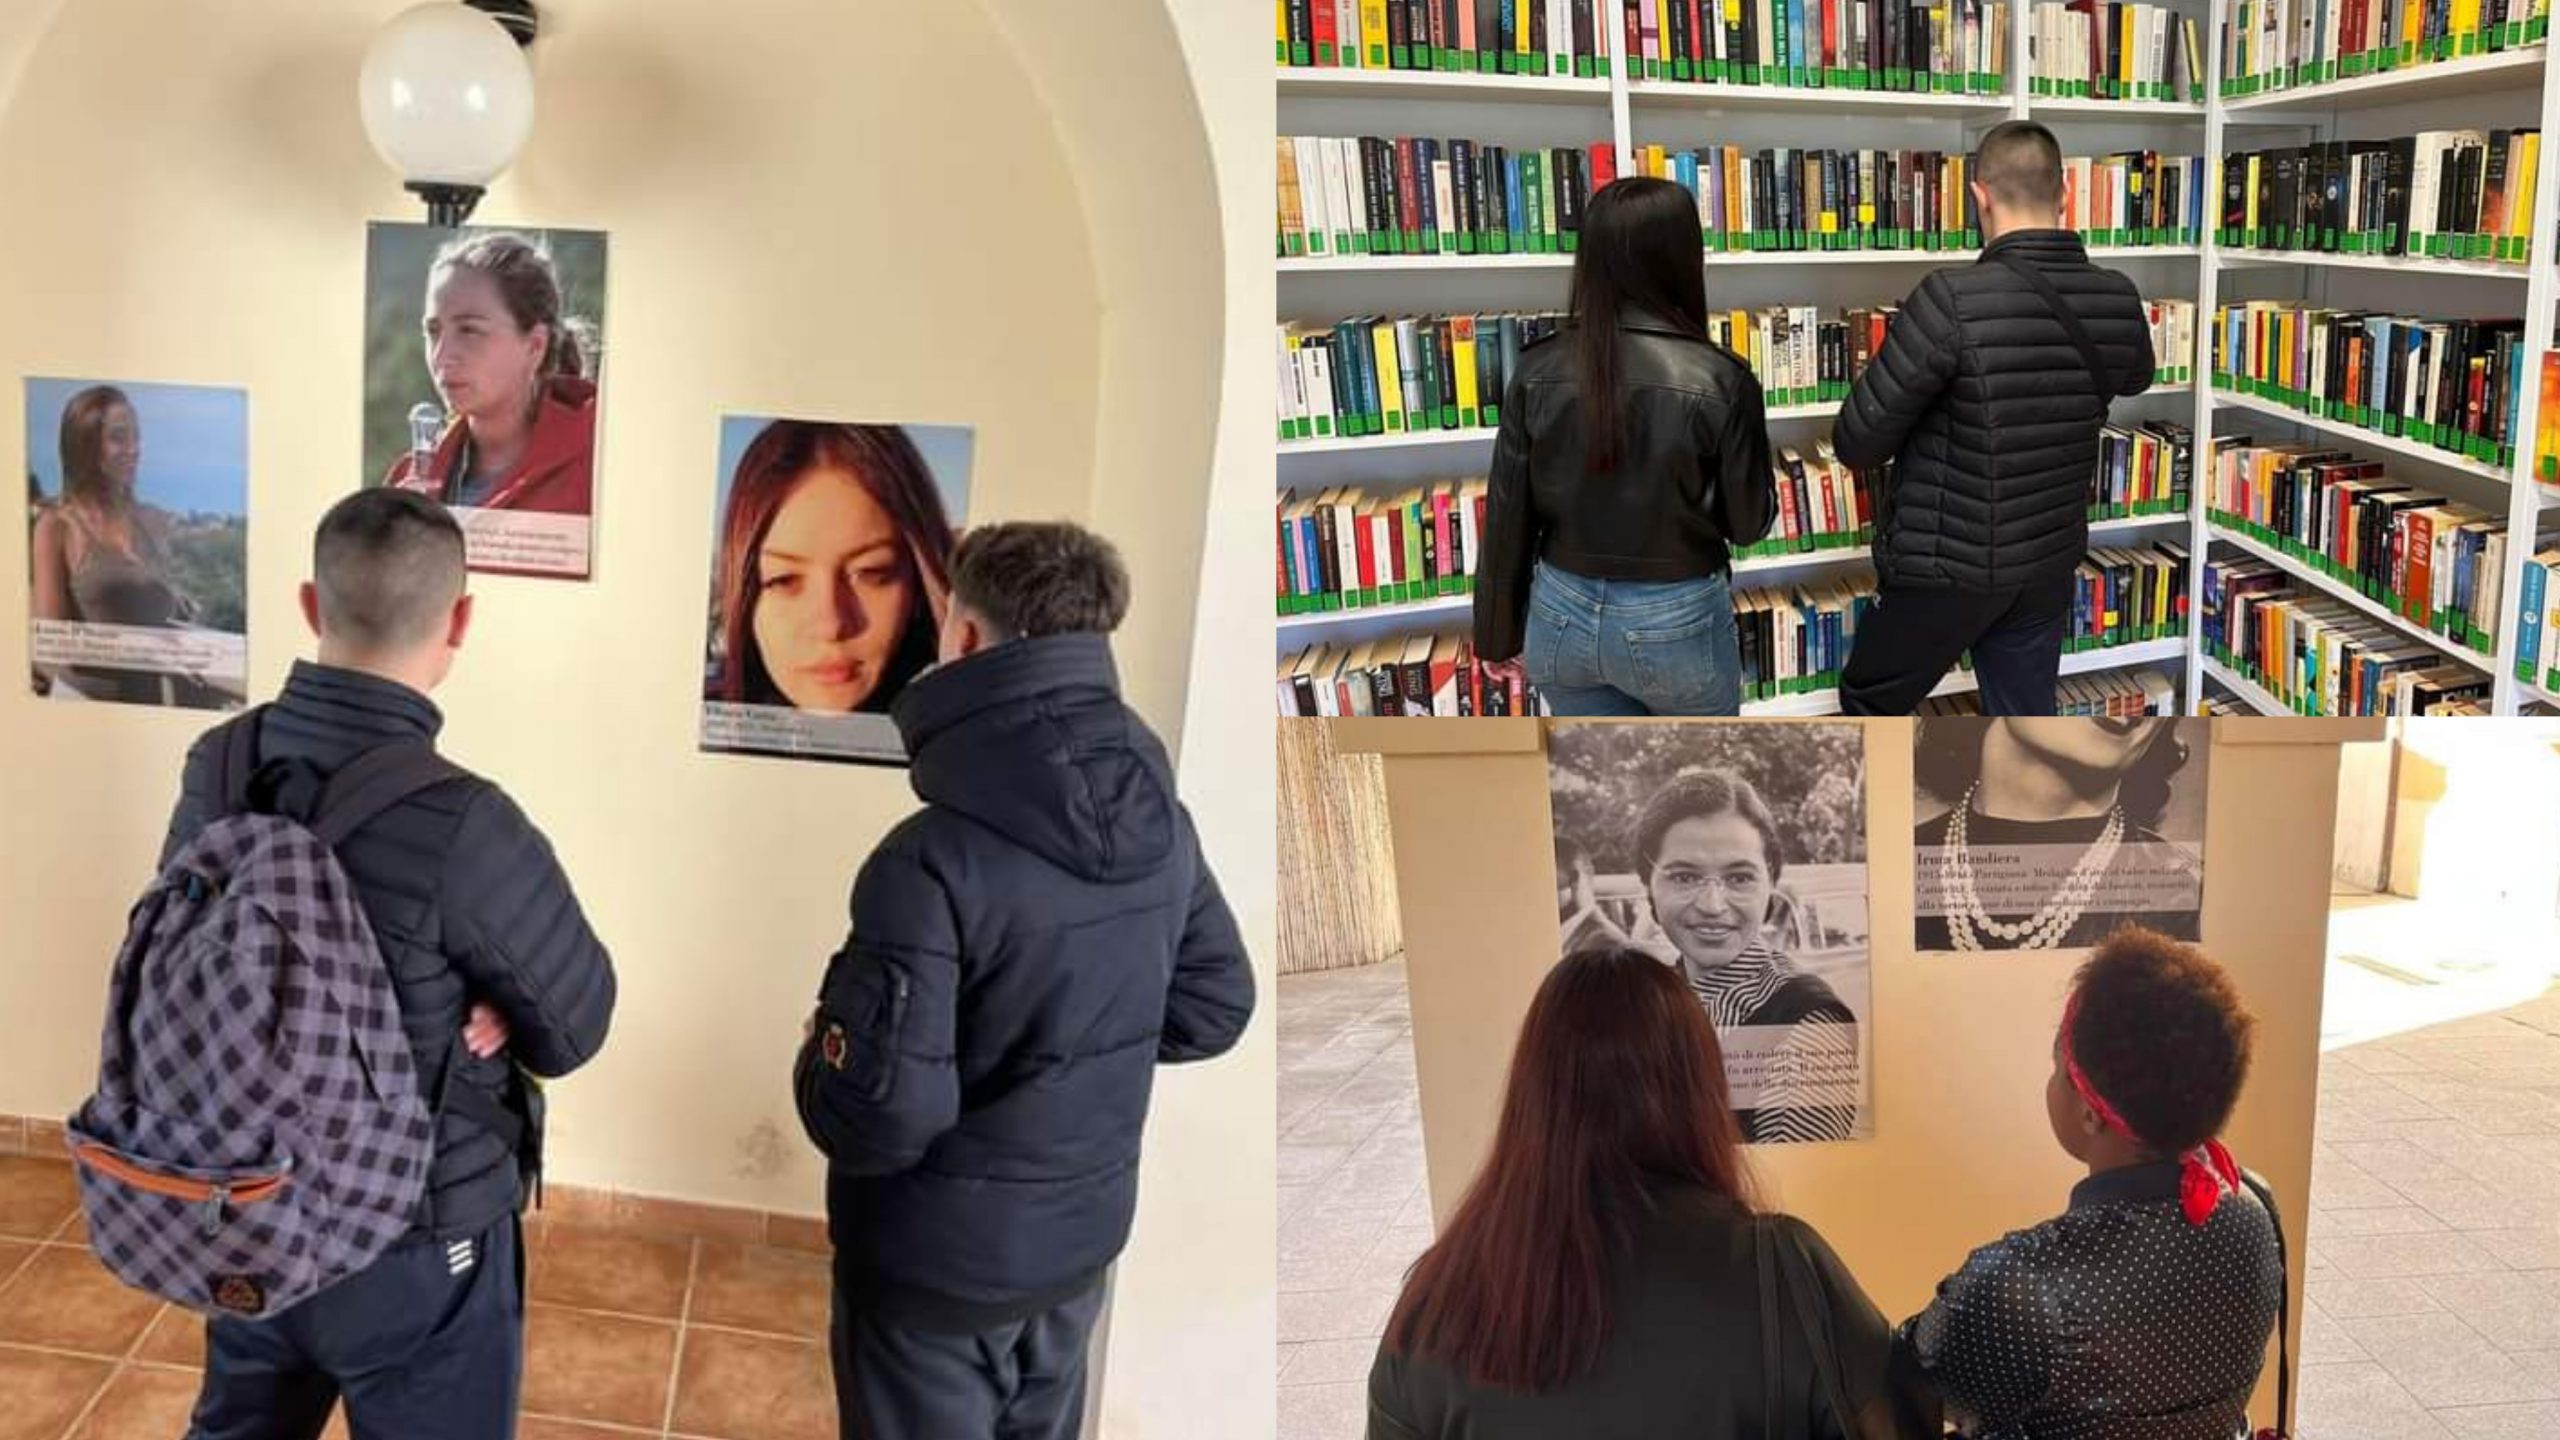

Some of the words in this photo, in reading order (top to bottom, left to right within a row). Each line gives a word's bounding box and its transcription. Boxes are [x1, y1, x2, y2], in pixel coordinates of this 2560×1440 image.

[1917, 852, 1952, 865] Irma
[1957, 852, 2021, 865] Bandiera
[1742, 1049, 1753, 1058] di
